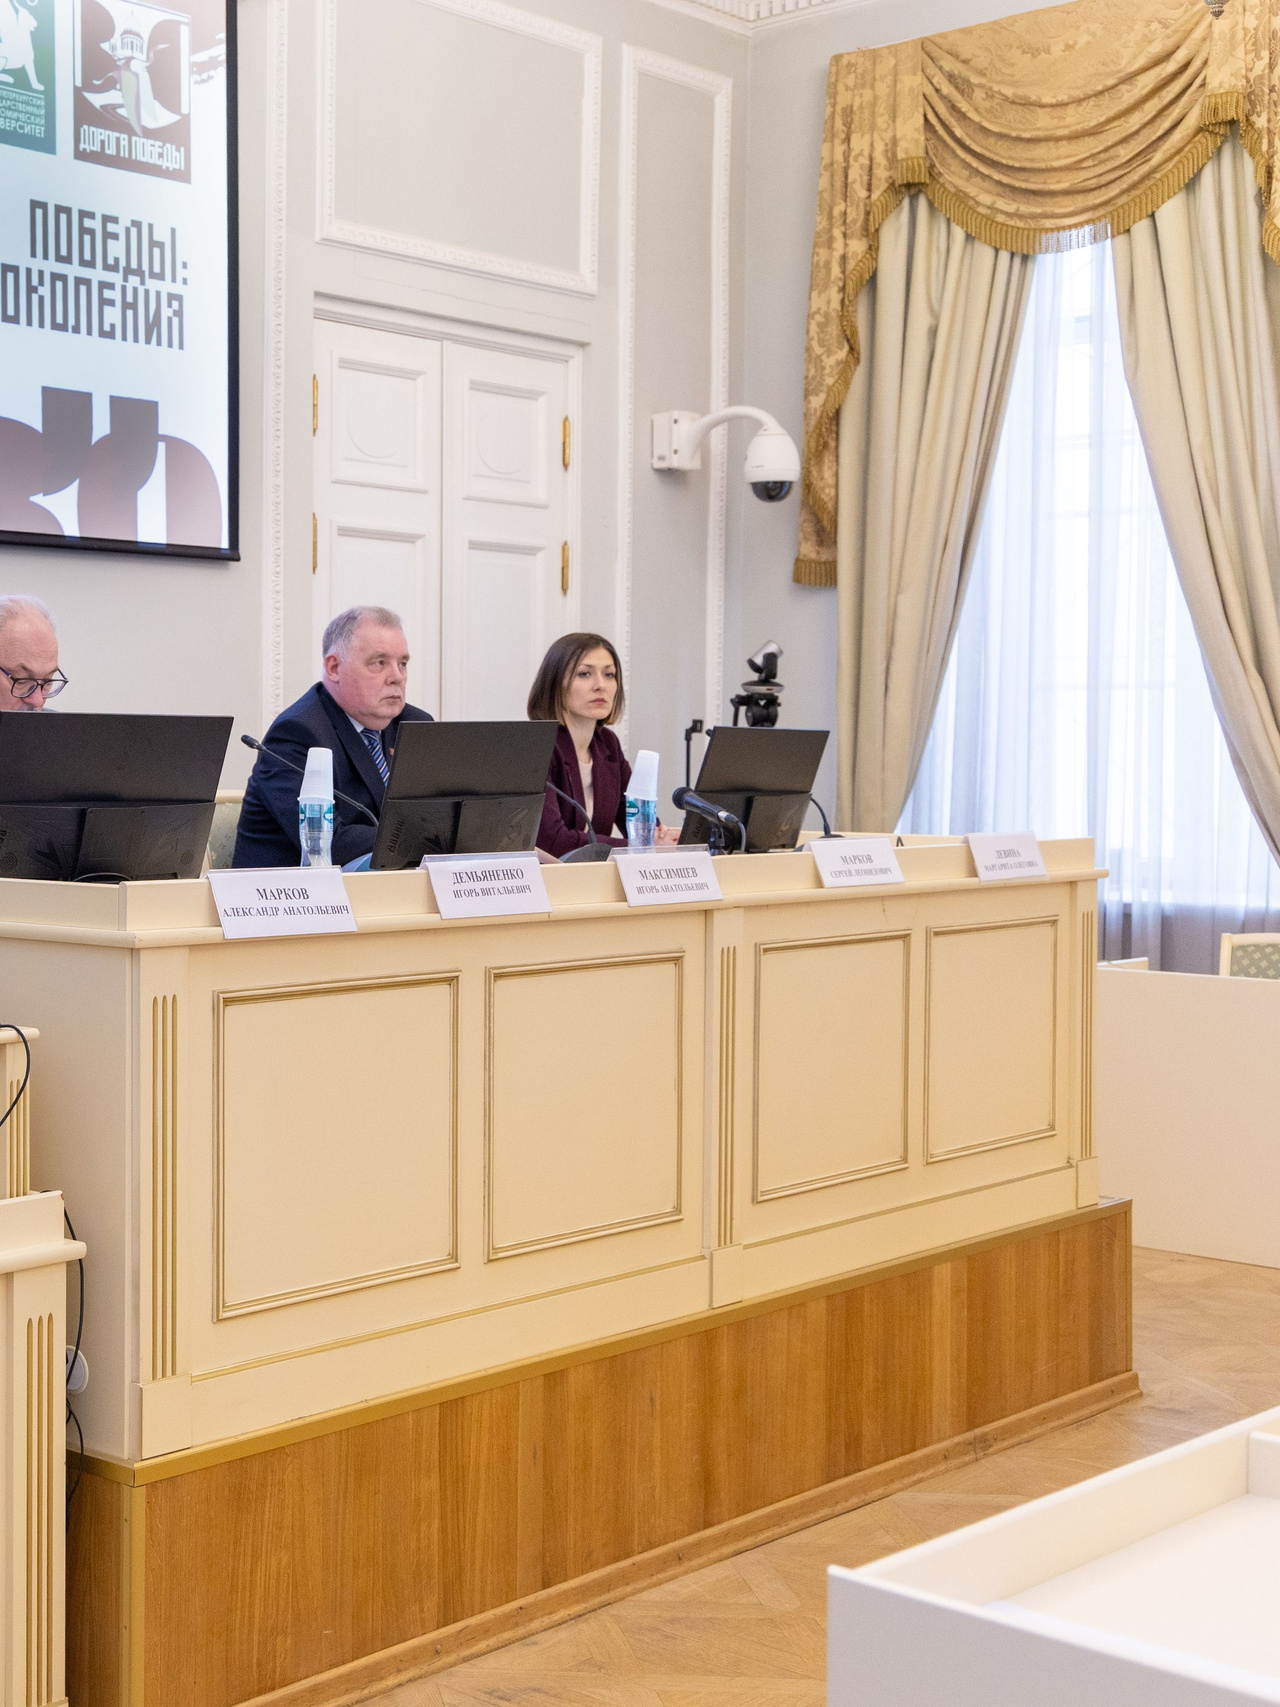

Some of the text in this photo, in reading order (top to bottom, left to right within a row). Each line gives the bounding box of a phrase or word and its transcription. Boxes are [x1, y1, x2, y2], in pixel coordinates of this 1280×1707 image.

[79, 124, 185, 171] ДОРОГА ПОБЕДЫ
[29, 198, 188, 286] ПОБЕДЫ:
[840, 854, 873, 865] МАРКОВ
[452, 867, 524, 885] ДЕМЬЯНЕНКО
[638, 867, 698, 881] МАКСИМЦЕВ
[830, 868, 853, 878] СЕРГЕЙ
[256, 887, 310, 901] МАРКОВ
[452, 884, 532, 899] ИГОРЬ ВИТАЛЬЕВИЧ
[636, 882, 710, 895] ИГОРЬ АНАТОЛЬЕВИЧ
[222, 905, 350, 917] АЛЕКСАНДР АНАТОЛЬЕВИЧ
